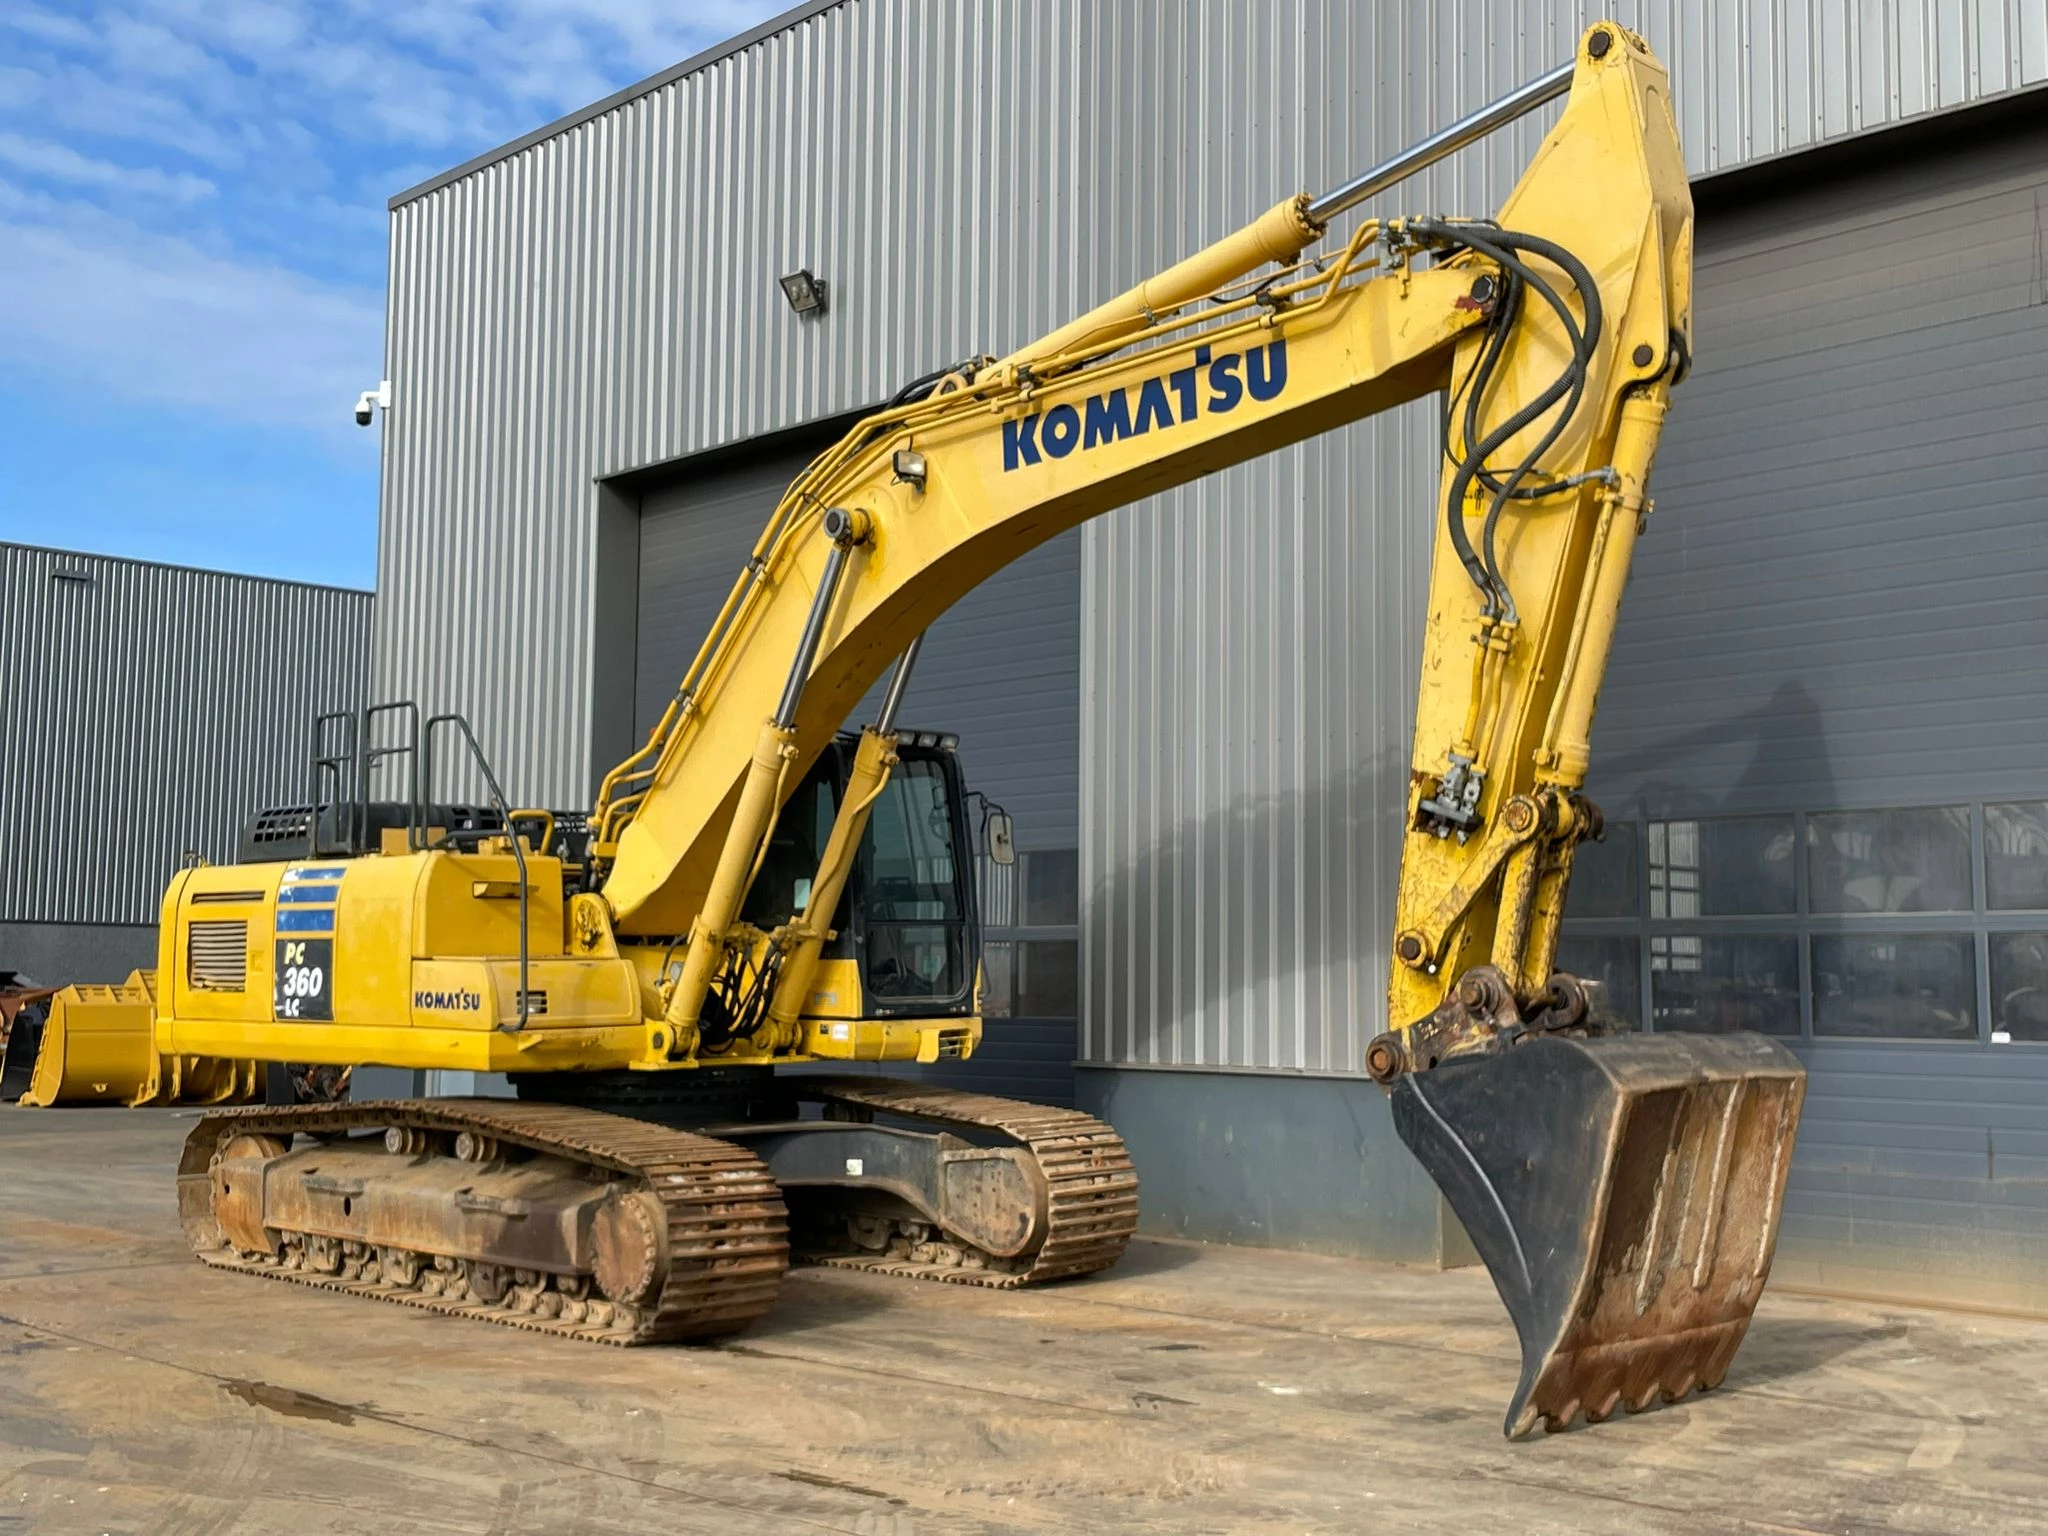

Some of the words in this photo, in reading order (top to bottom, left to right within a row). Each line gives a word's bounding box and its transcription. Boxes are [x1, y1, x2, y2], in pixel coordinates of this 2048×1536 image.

[1001, 338, 1288, 472] KOMATSU
[284, 942, 306, 965] PC
[283, 967, 323, 997] 360
[285, 998, 300, 1017] LC
[415, 987, 480, 1010] KOMATSU
